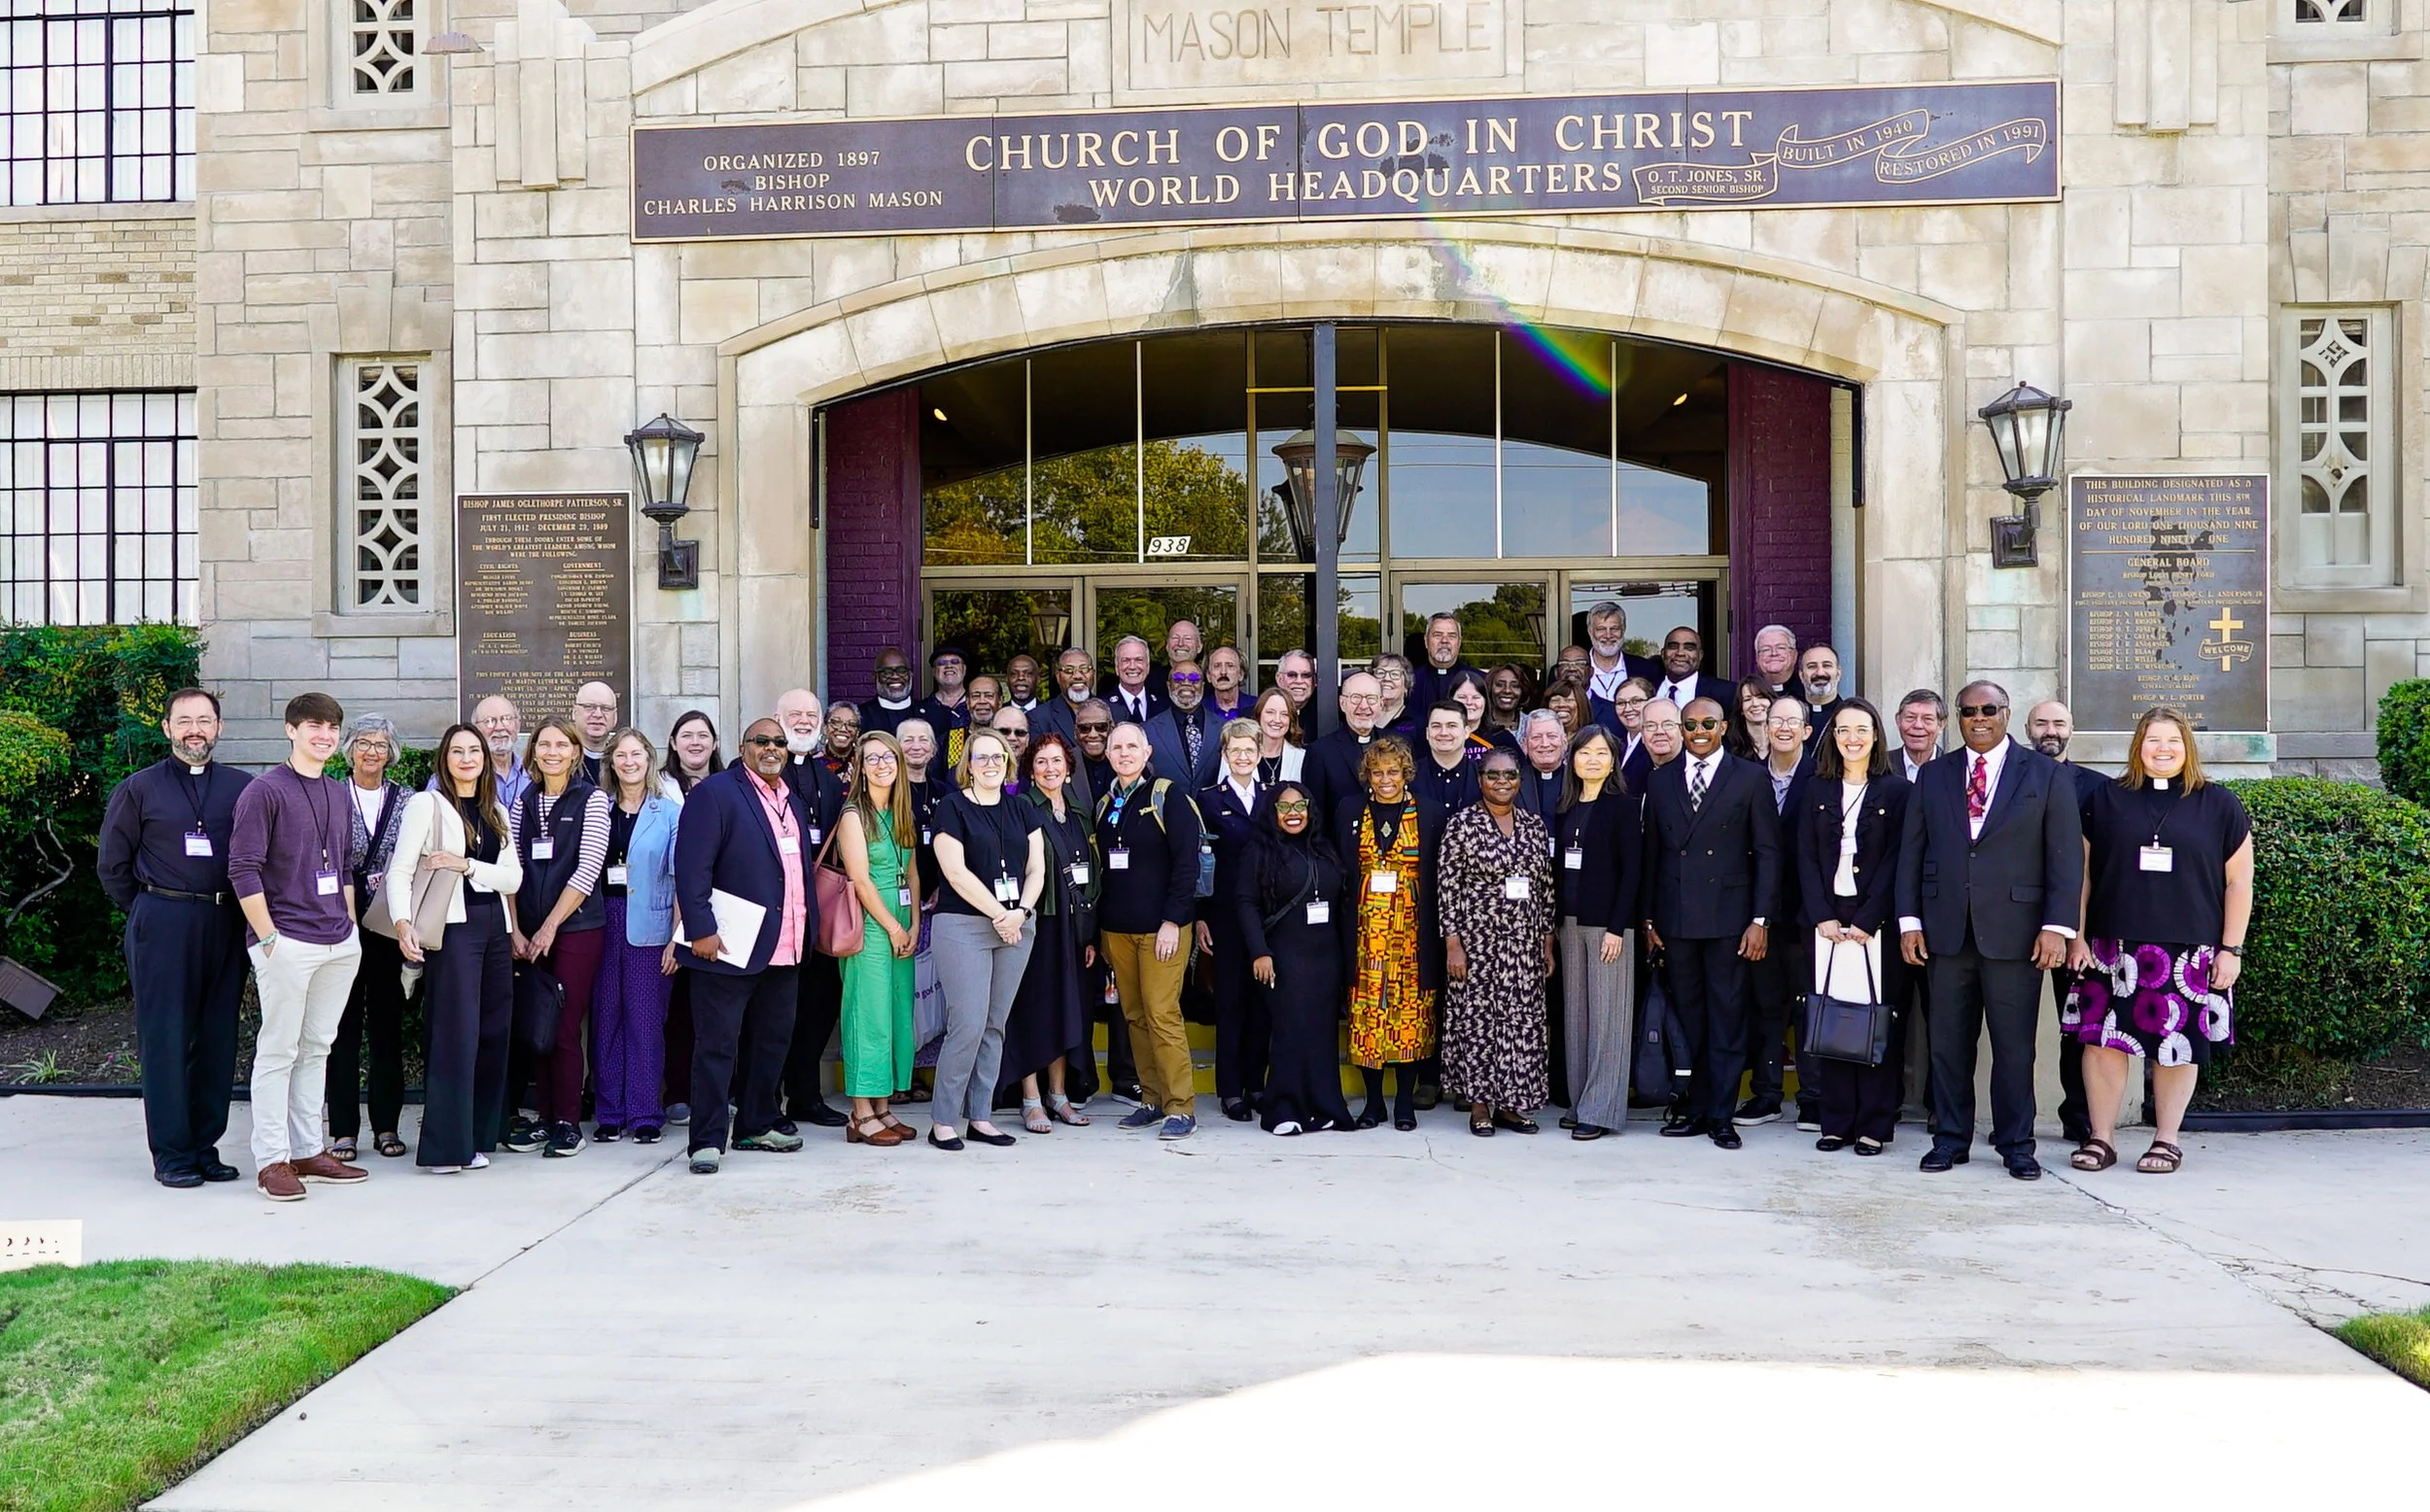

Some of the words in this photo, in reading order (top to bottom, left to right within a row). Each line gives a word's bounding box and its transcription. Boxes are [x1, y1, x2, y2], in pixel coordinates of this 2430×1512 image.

[1143, 7, 1292, 63] MASON
[1316, 1, 1491, 57] TEMPLE
[964, 128, 1181, 173] CHURCH
[1215, 123, 1281, 164] OF
[1316, 120, 1430, 159] GOD
[1465, 117, 1519, 155] IN
[1554, 111, 1753, 152] CHRIST
[1783, 143, 1835, 162] BUILT
[1847, 134, 1865, 152] IN
[1874, 119, 1914, 144] 1940
[1878, 141, 1973, 177] RESTORED
[1976, 132, 1997, 152] IN
[2002, 122, 2041, 144] 1991
[704, 153, 824, 172] ORGANIZED
[837, 151, 881, 166] 1897
[754, 173, 831, 192] BISHOP
[1648, 170, 1663, 184] O.
[1668, 170, 1683, 183] T.
[1686, 169, 1738, 185] JONES,
[1744, 169, 1767, 183] SR.
[1088, 174, 1241, 209] WORLD
[1267, 161, 1622, 203] HEADQUARTERS
[1650, 185, 1688, 194] SECOND
[1691, 185, 1726, 194] SENIOR
[1729, 185, 1764, 194] BISHOP
[643, 197, 738, 216] CHARLES
[749, 193, 857, 213] HARRISON
[868, 190, 944, 209] MASON
[2085, 481, 2107, 490] THIS
[2111, 480, 2159, 489] BUILDING
[2163, 479, 2224, 489] DESIGNATED
[2228, 479, 2241, 488] AS
[463, 499, 489, 508] BISHOP
[492, 499, 515, 508] JAMES
[517, 499, 564, 508] OGLETHORPE
[567, 498, 610, 508] PATTERSON,
[612, 498, 625, 507] SR.
[2087, 494, 2145, 503] HISTORICAL
[2150, 493, 2204, 502] LANDMARK
[2209, 493, 2232, 502] THIS
[2086, 508, 2106, 517] DAY
[2111, 508, 2124, 516] OF
[2129, 507, 2182, 516] NOVEMBER
[2186, 507, 2198, 516] IN
[2203, 507, 2221, 516] THE
[2225, 507, 2251, 516] YEAR
[2079, 522, 2092, 531] OF
[2098, 522, 2118, 531] OUR
[2122, 521, 2148, 531] LORD
[2153, 521, 2173, 530] ONE
[2178, 520, 2230, 530] THOUSAND
[2234, 520, 2259, 530] NINE
[1151, 538, 1187, 553] 938
[2108, 535, 2156, 545] HUNDRED
[2160, 535, 2196, 545] NINETY
[2208, 534, 2230, 544] ONE
[2127, 558, 2172, 567] GENERAL
[2176, 557, 2210, 567] BOARD
[2203, 645, 2250, 654] WELCOME
